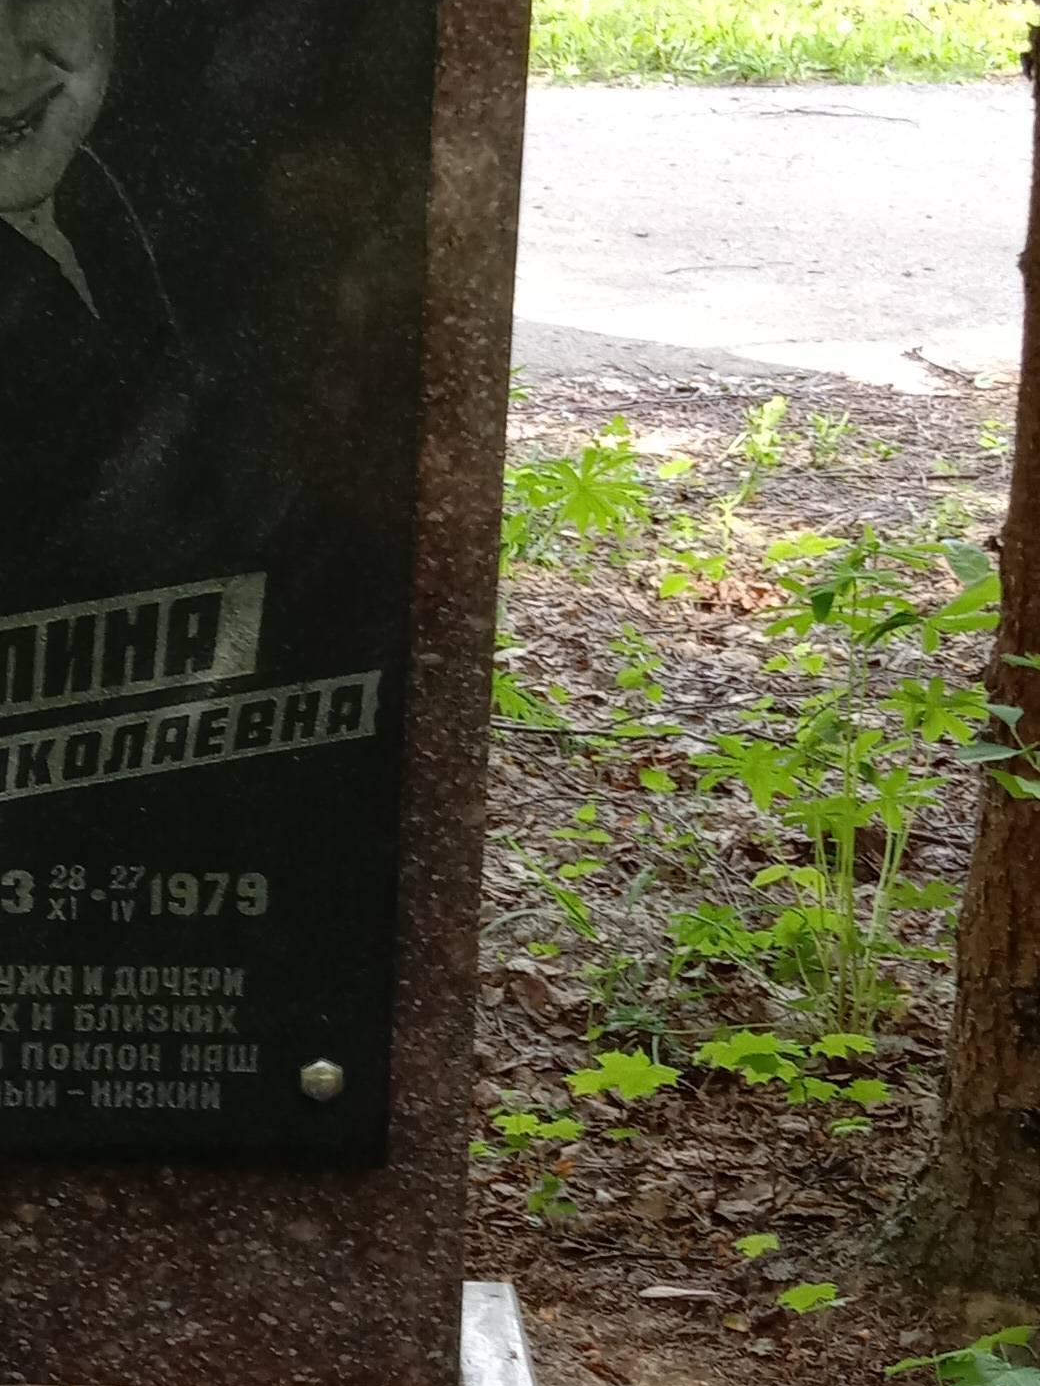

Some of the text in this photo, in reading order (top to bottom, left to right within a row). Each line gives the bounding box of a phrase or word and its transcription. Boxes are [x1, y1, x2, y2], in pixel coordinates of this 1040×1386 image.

[48, 865, 86, 891] 28
[109, 865, 145, 889] 27
[150, 872, 269, 916] 1979
[47, 897, 135, 922] XI IV
[83, 966, 104, 996] И
[111, 965, 245, 999] ДОЧЕРИ
[31, 1002, 54, 1032] И
[72, 1004, 239, 1034] БЛИЗКИХ
[21, 1043, 160, 1072] ПОКЛОН
[180, 1044, 258, 1074] НАШ
[91, 1077, 221, 1110] НИЗКИЙ
